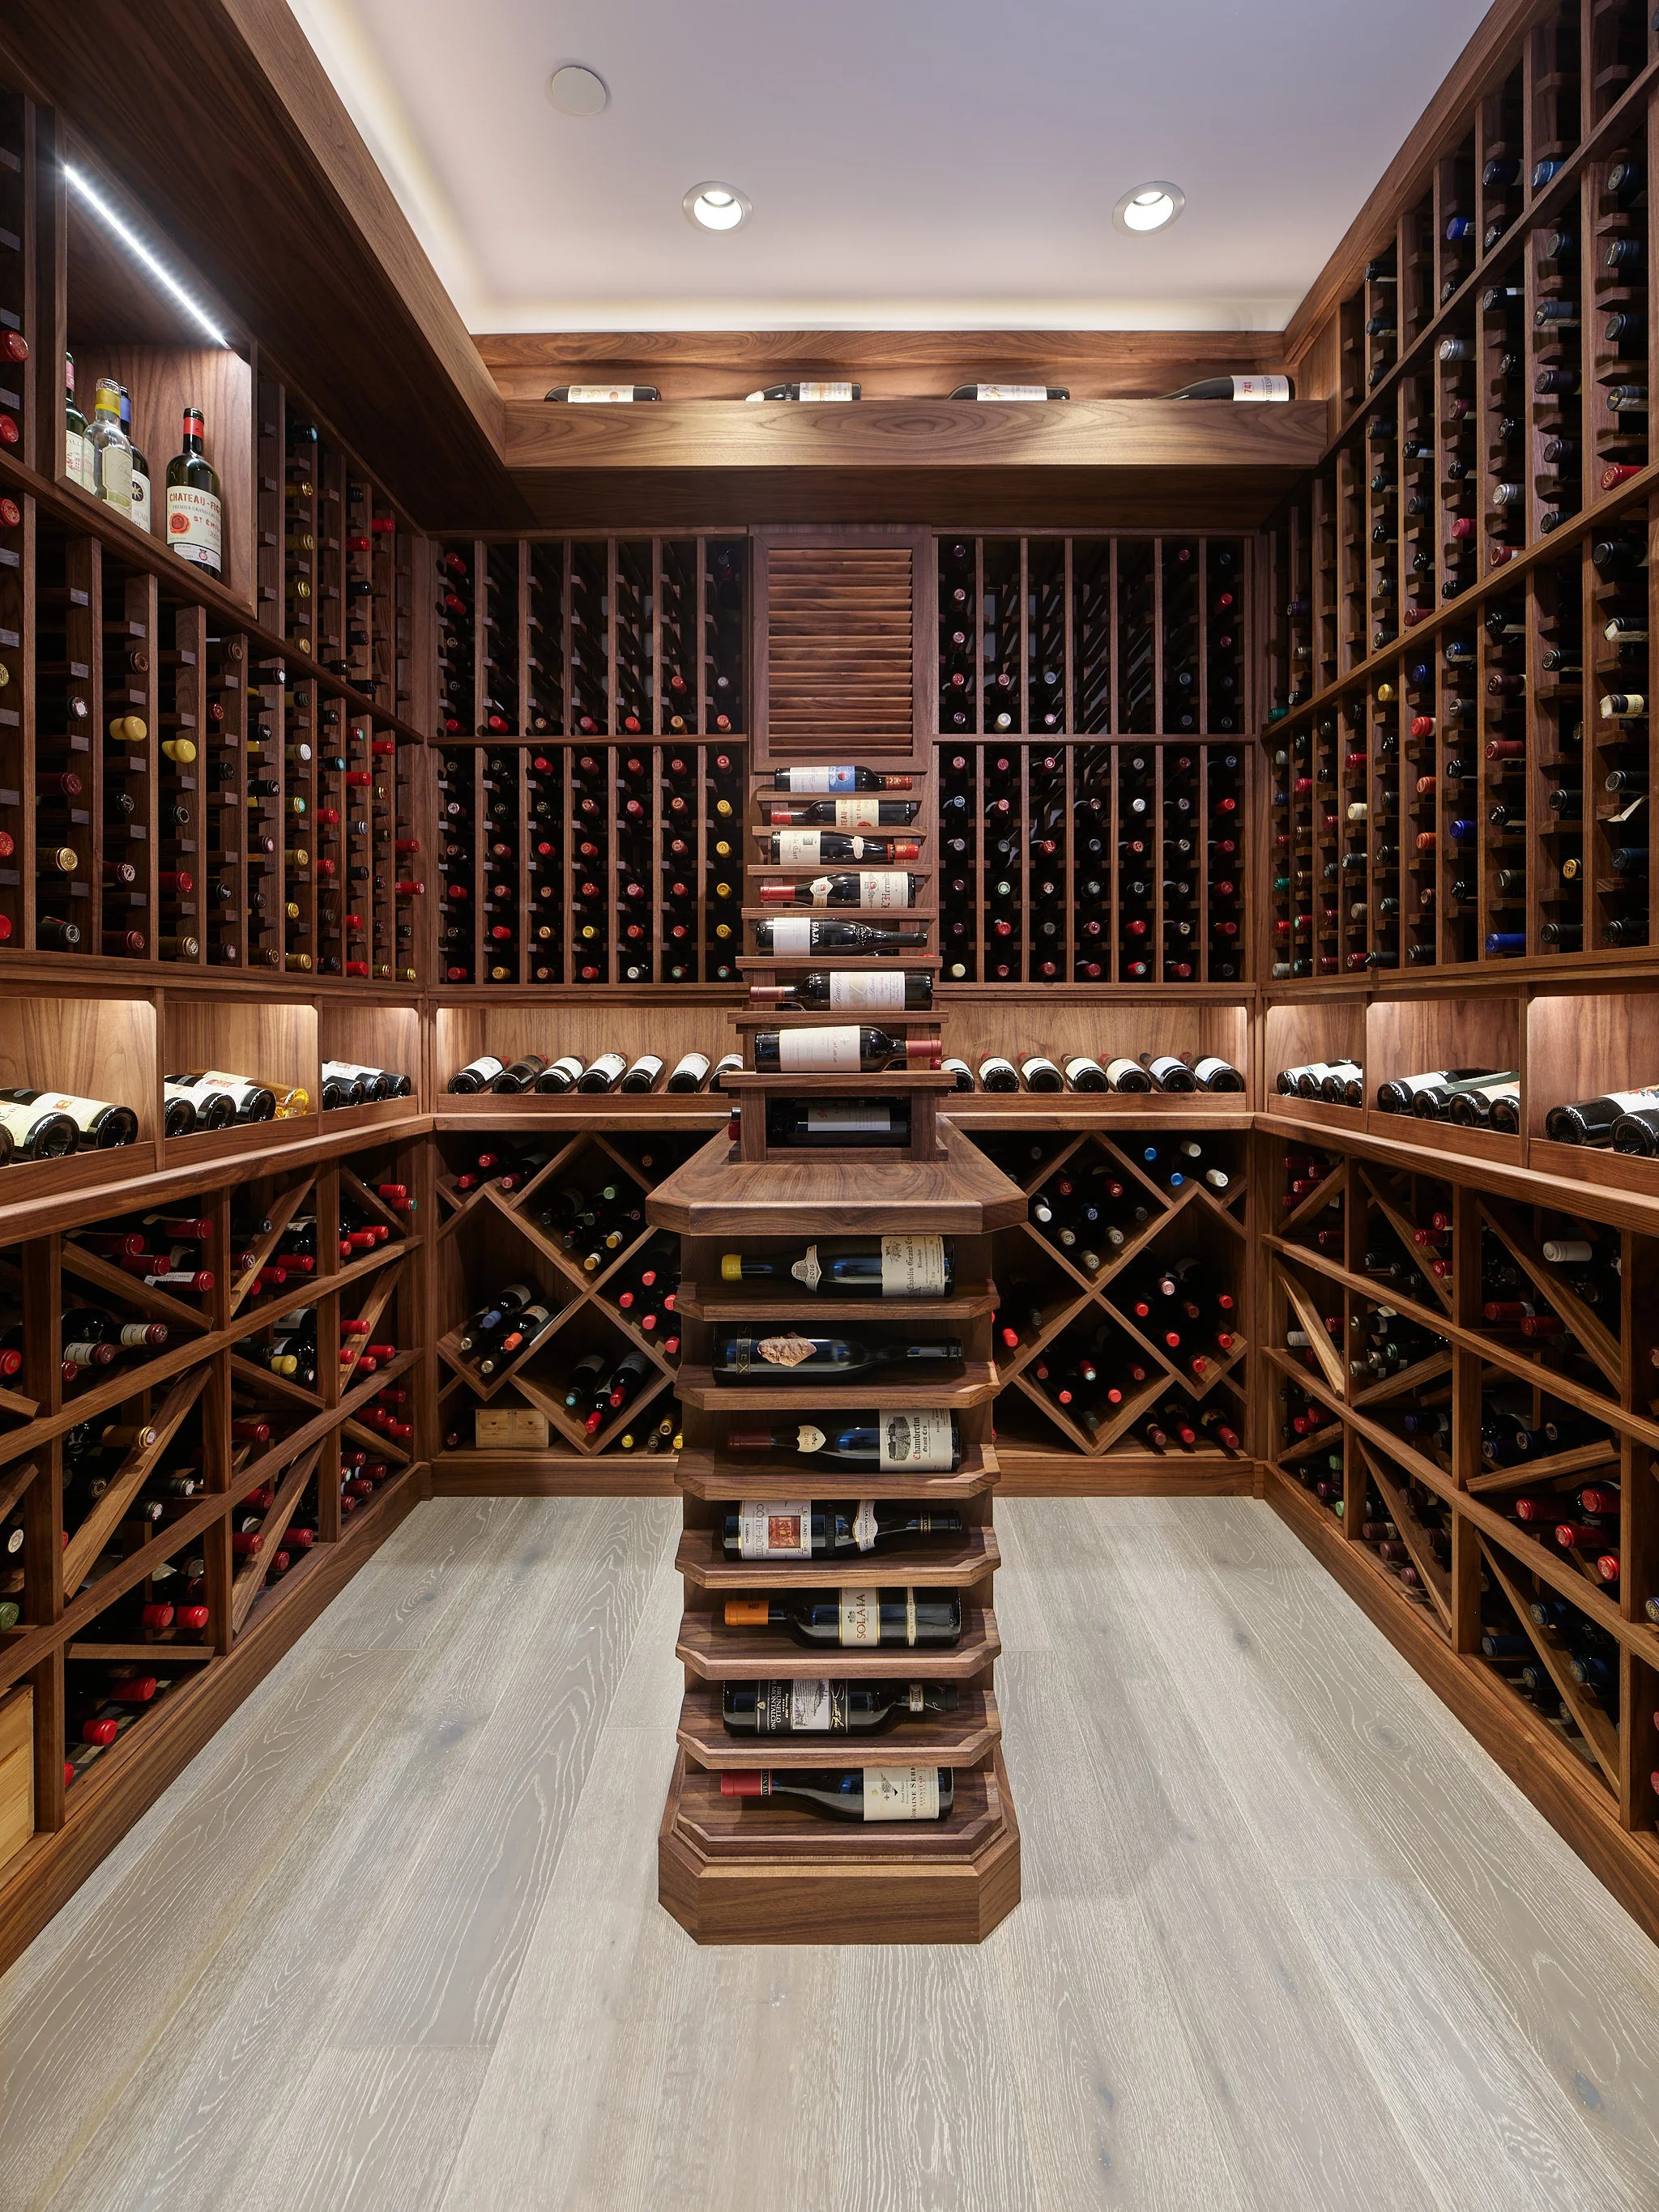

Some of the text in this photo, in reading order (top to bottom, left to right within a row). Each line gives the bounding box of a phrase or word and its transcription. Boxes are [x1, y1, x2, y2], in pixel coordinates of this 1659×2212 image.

[1243, 381, 1252, 394] 741
[906, 1246, 914, 1266] Grand
[906, 1268, 915, 1290] Chablis
[913, 1417, 921, 1460] Chambertin
[856, 1593, 866, 1639] SOLAIA
